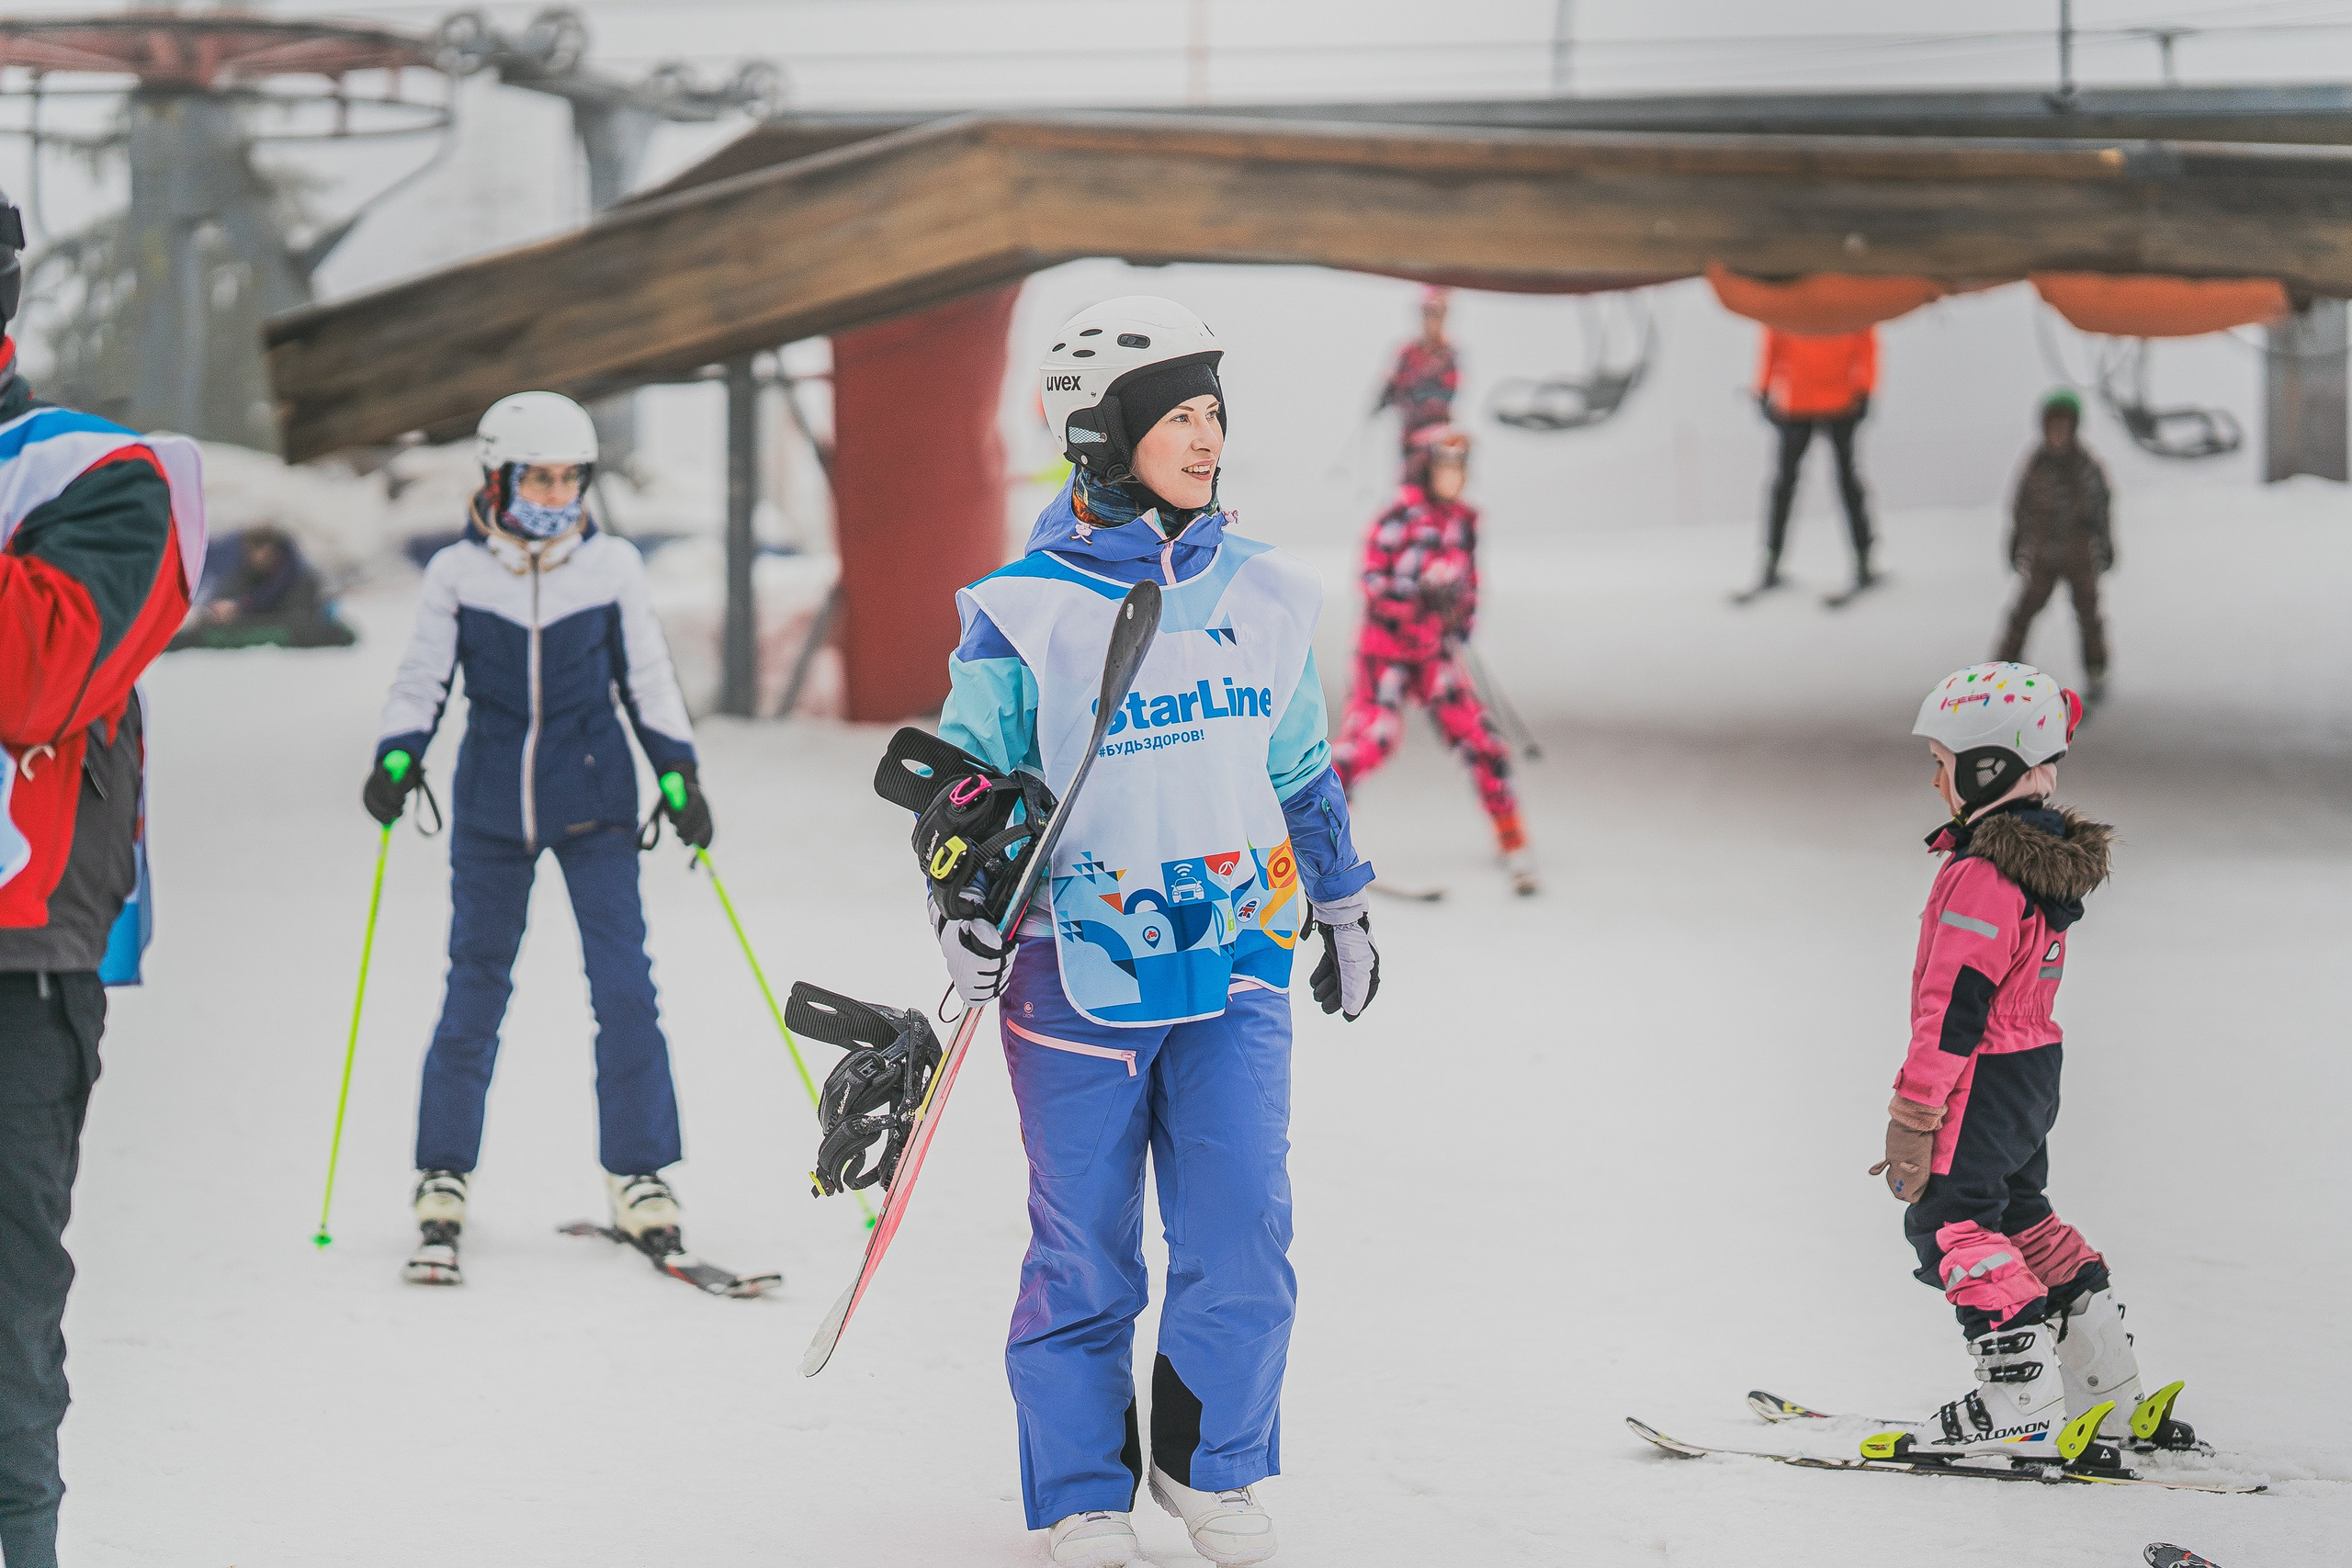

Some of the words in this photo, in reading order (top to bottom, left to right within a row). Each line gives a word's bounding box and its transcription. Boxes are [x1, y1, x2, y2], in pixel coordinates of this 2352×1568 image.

[1046, 375, 1082, 391] uvex
[1098, 729, 1205, 758] #БУДЬЗДОРОВ!
[1963, 1419, 2050, 1446] SALOMON
